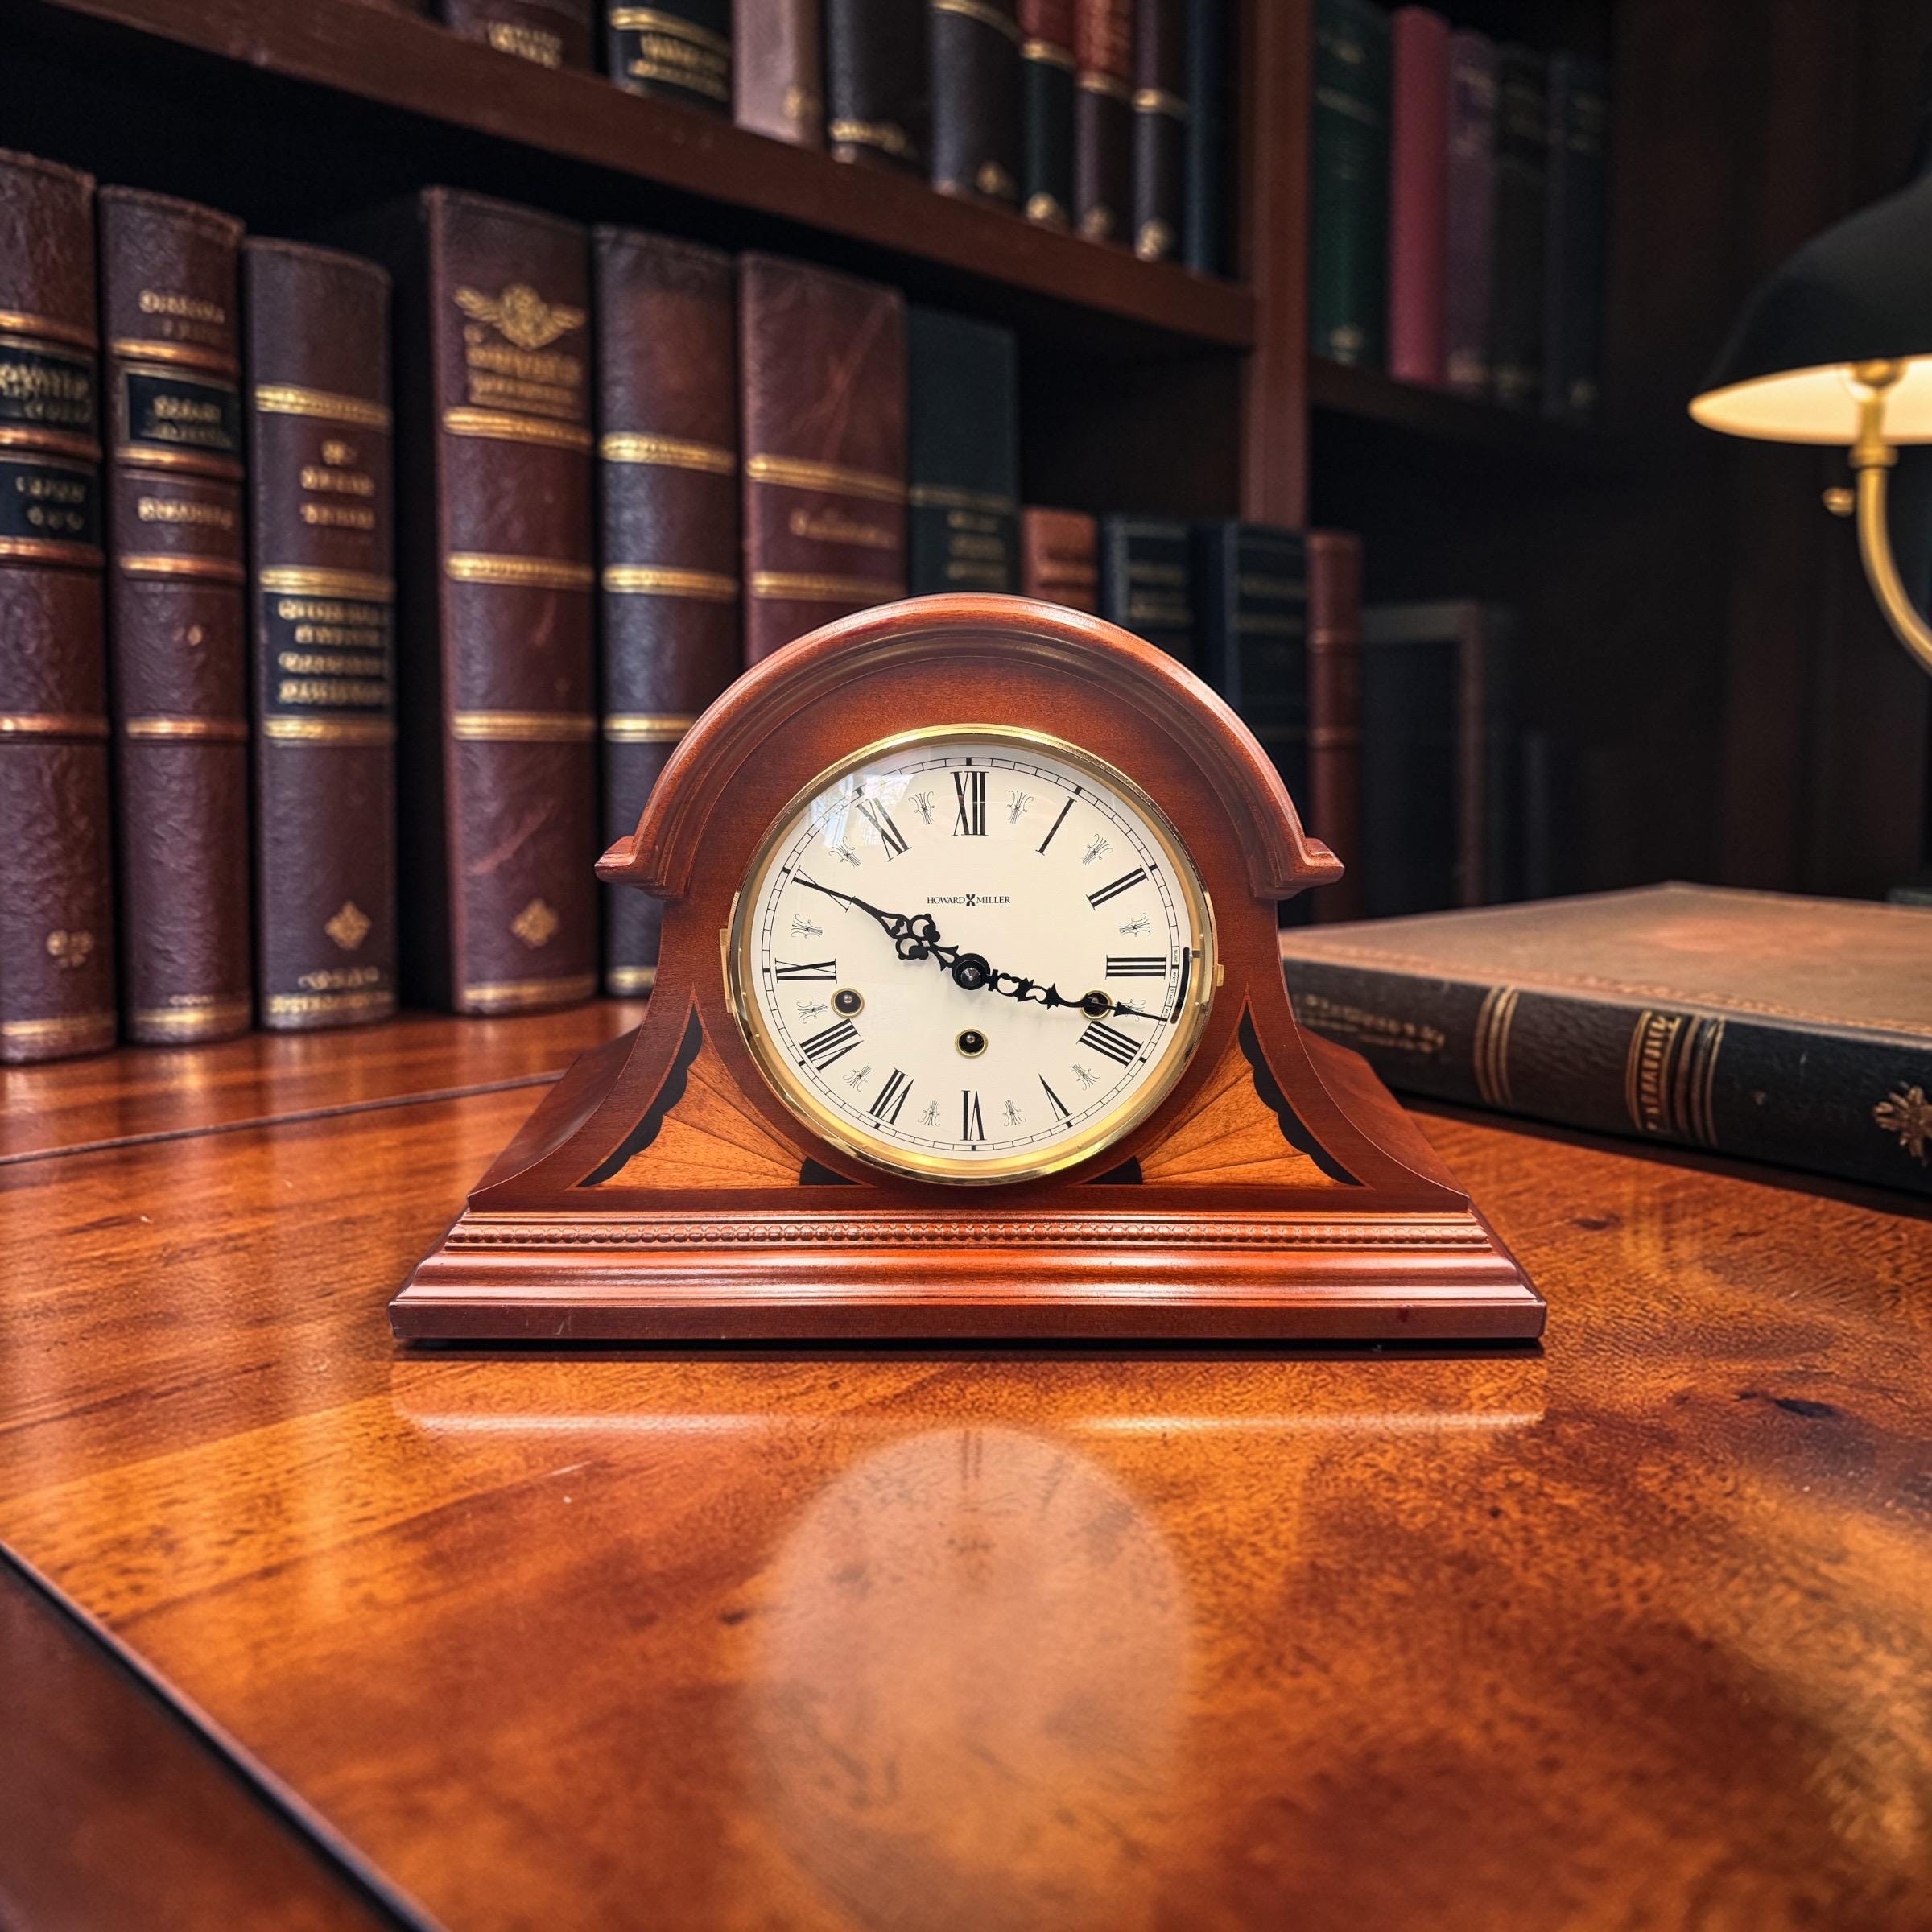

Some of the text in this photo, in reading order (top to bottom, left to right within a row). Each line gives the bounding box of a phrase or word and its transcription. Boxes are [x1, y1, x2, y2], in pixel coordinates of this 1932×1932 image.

[855, 795, 912, 862] XI
[950, 771, 989, 836] XII
[1035, 796, 1077, 856] I
[927, 896, 1011, 904] HOWARD MILLER
[1086, 865, 1149, 910] II
[774, 957, 837, 984] IX
[1105, 954, 1167, 980] III
[798, 1018, 865, 1074] VIII
[866, 1067, 914, 1125] VII
[960, 1090, 987, 1141] VI
[1038, 1073, 1072, 1122] V
